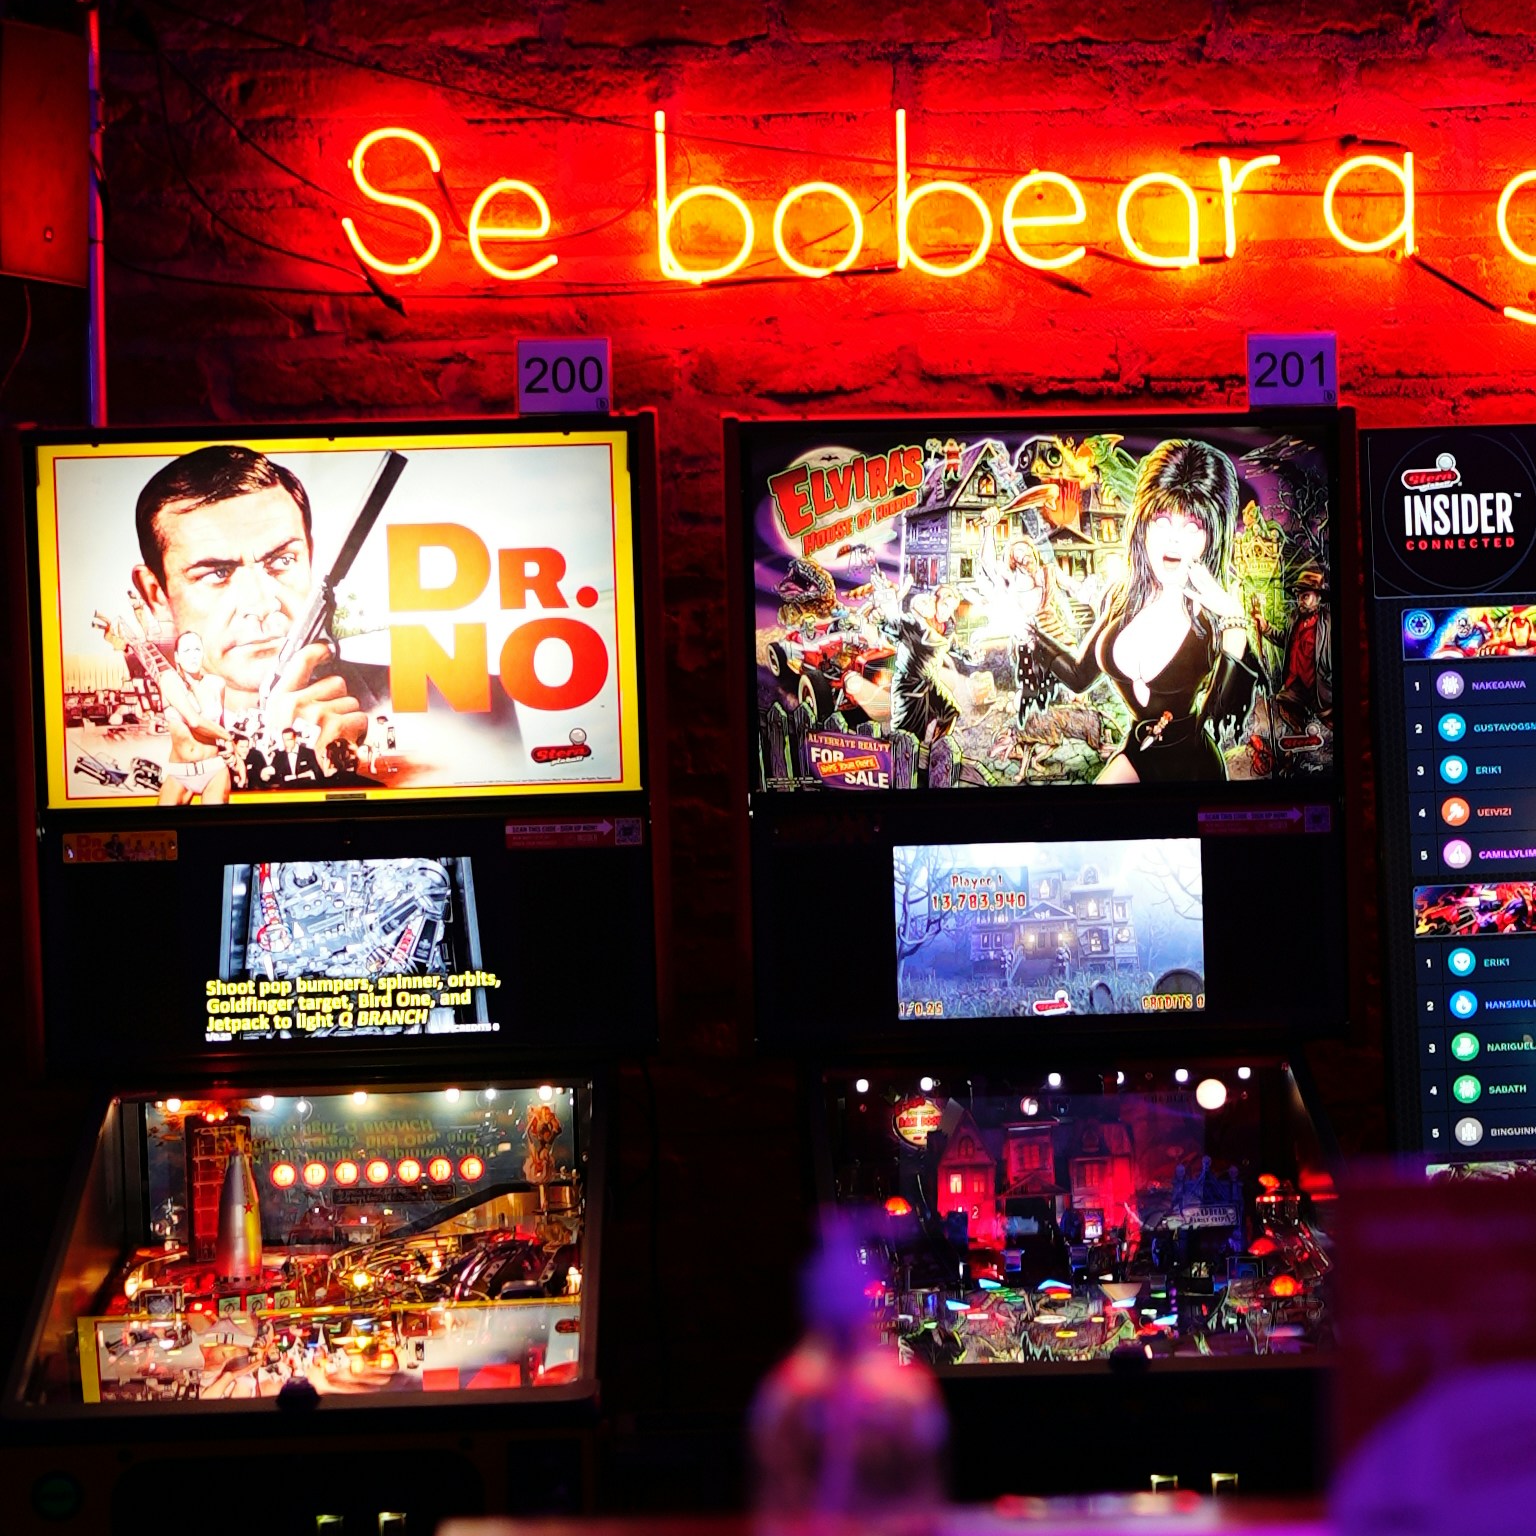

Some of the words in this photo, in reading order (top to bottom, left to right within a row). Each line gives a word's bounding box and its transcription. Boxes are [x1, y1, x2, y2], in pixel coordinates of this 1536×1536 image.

[343, 127, 557, 279] Se
[653, 107, 1281, 283] bobear
[1321, 150, 1416, 260] a
[524, 355, 603, 394] 200
[1254, 350, 1326, 388] 201
[768, 446, 924, 537] ELVIRA'S
[803, 517, 853, 557] HOUSE
[857, 508, 873, 530] OF
[876, 490, 919, 523] HORRORS
[1404, 493, 1514, 536] INSIDER
[1406, 538, 1514, 550] CONNECTED
[386, 522, 599, 613] DR.
[388, 617, 609, 713] NO
[1473, 681, 1526, 689] NAKEGAWA
[808, 733, 856, 749] ALTERNATE
[811, 746, 845, 763] FOR
[844, 770, 890, 789] SALE
[205, 978, 256, 997] Shoot
[259, 979, 293, 998] pop
[296, 976, 374, 995] bumpers,
[377, 973, 444, 993] spinner,
[447, 970, 501, 989] orbits,
[206, 996, 295, 1016] Goldfinger
[298, 993, 355, 1012] target,
[358, 991, 393, 1009] Bird
[396, 990, 436, 1009] One,
[439, 988, 472, 1006] and
[1141, 995, 1193, 1010] CREDITS
[1196, 994, 1205, 1009] 0
[206, 1014, 270, 1034] Jetpack
[273, 1015, 293, 1030] to
[296, 1012, 334, 1033] light
[337, 1011, 354, 1029] Q
[356, 1009, 428, 1027] BRANCH
